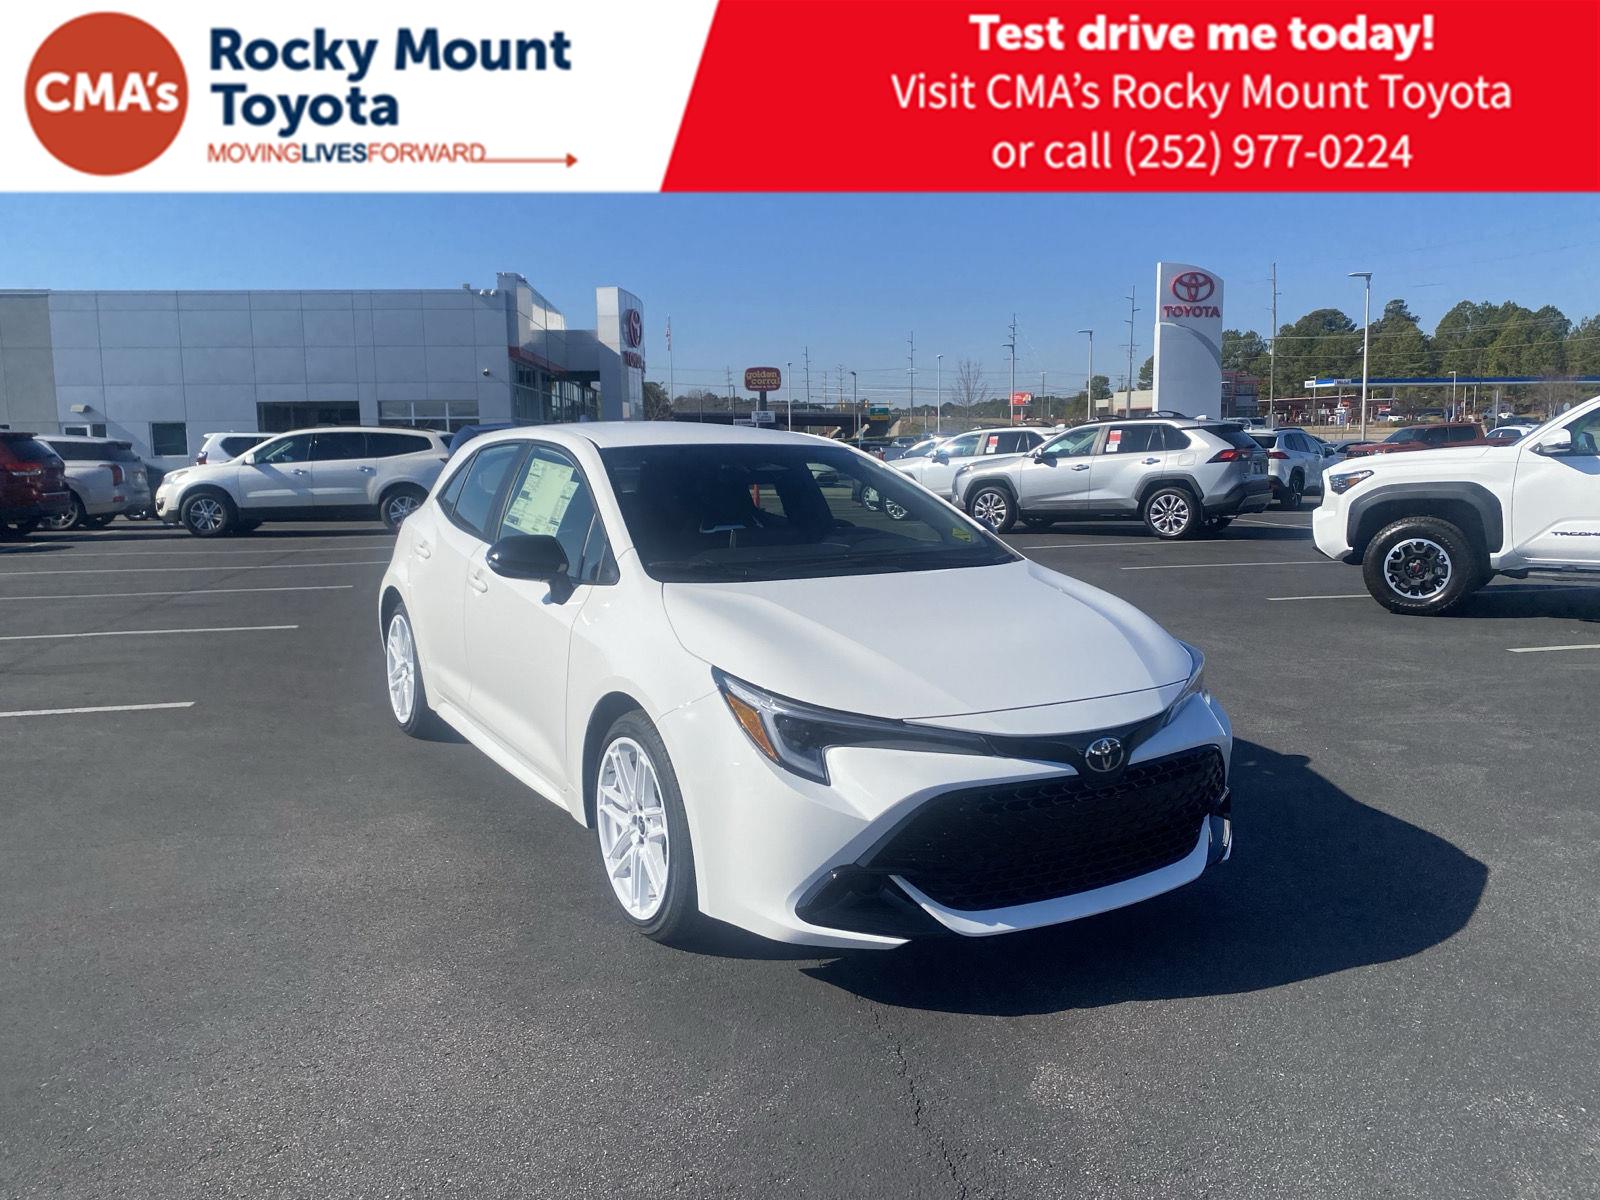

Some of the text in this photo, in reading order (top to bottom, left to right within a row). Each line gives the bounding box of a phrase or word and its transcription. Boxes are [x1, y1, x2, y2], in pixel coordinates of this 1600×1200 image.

[1163, 305, 1221, 318] TOYOTA
[746, 370, 777, 380] golden
[751, 377, 781, 385] corral
